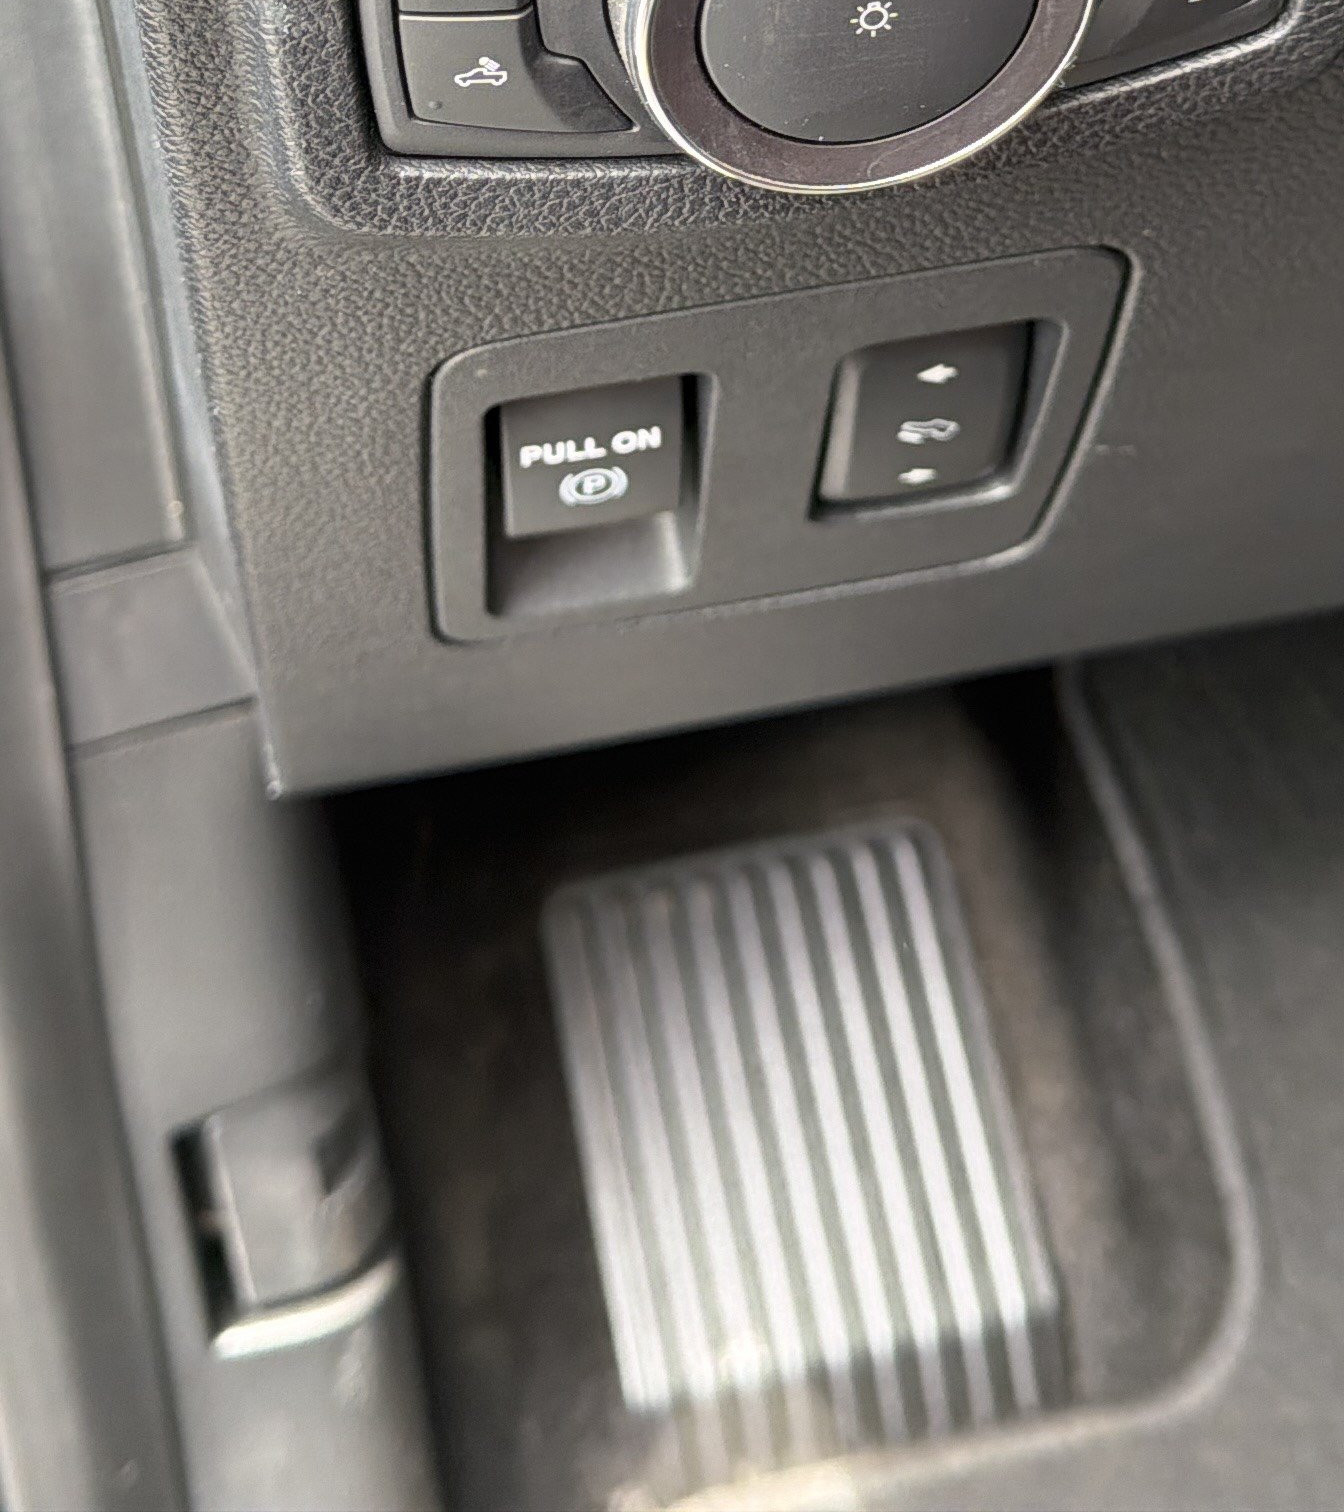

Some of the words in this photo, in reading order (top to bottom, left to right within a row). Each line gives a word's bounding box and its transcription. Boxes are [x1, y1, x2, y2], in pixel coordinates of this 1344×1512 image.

[519, 437, 607, 468] PULL
[611, 426, 662, 454] ON
[582, 474, 606, 494] P
